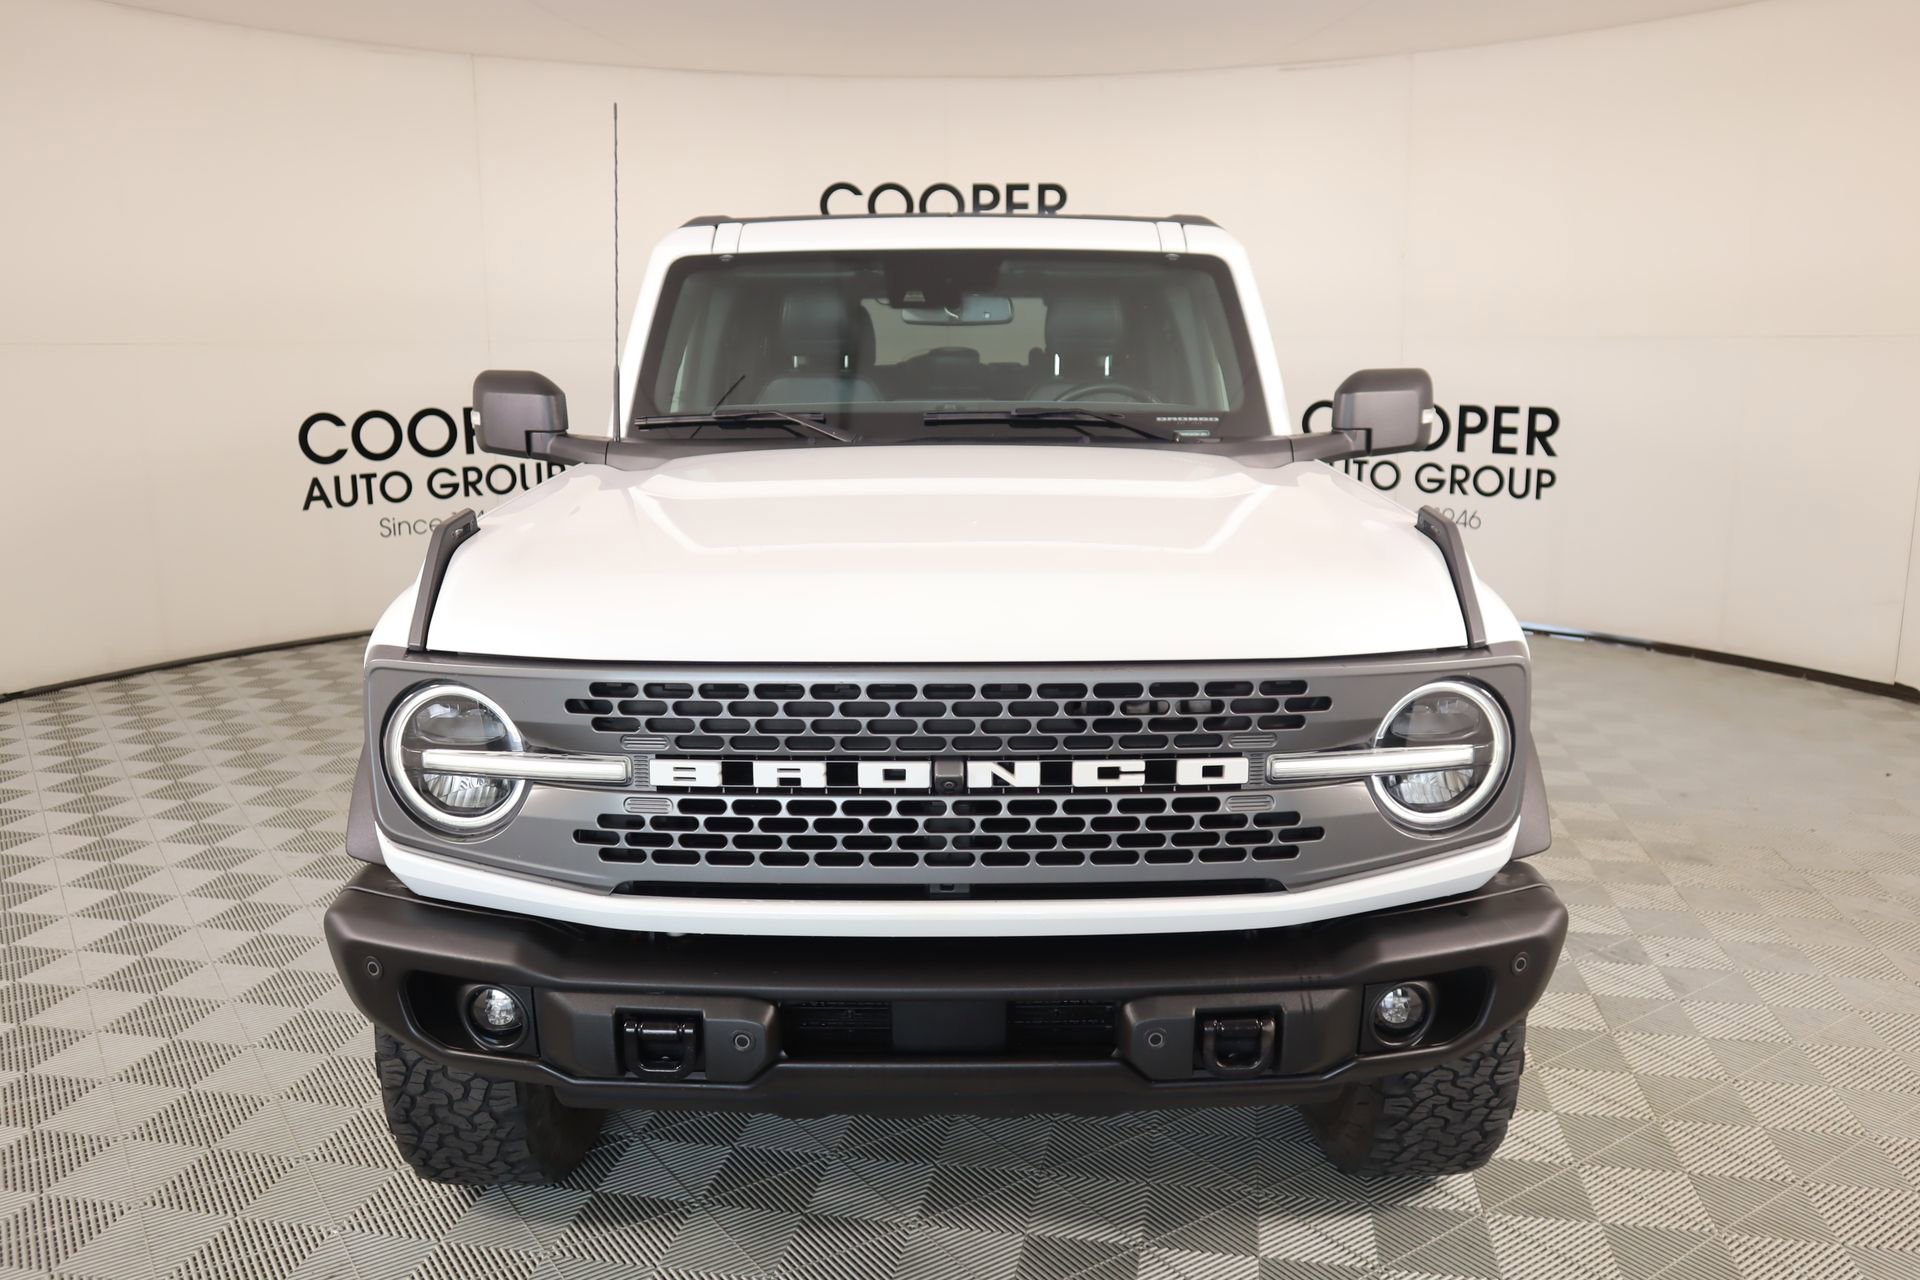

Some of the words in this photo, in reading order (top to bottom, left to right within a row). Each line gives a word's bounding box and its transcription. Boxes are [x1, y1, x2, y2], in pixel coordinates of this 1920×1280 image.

[820, 182, 1067, 215] COOPER
[298, 407, 475, 464] COO
[1302, 400, 1560, 457] PER
[302, 471, 413, 511] AUTO
[1329, 459, 1400, 491] TO
[1415, 462, 1557, 500] GROUP
[1437, 507, 1482, 529] 946
[649, 757, 1249, 789] BRONCO
